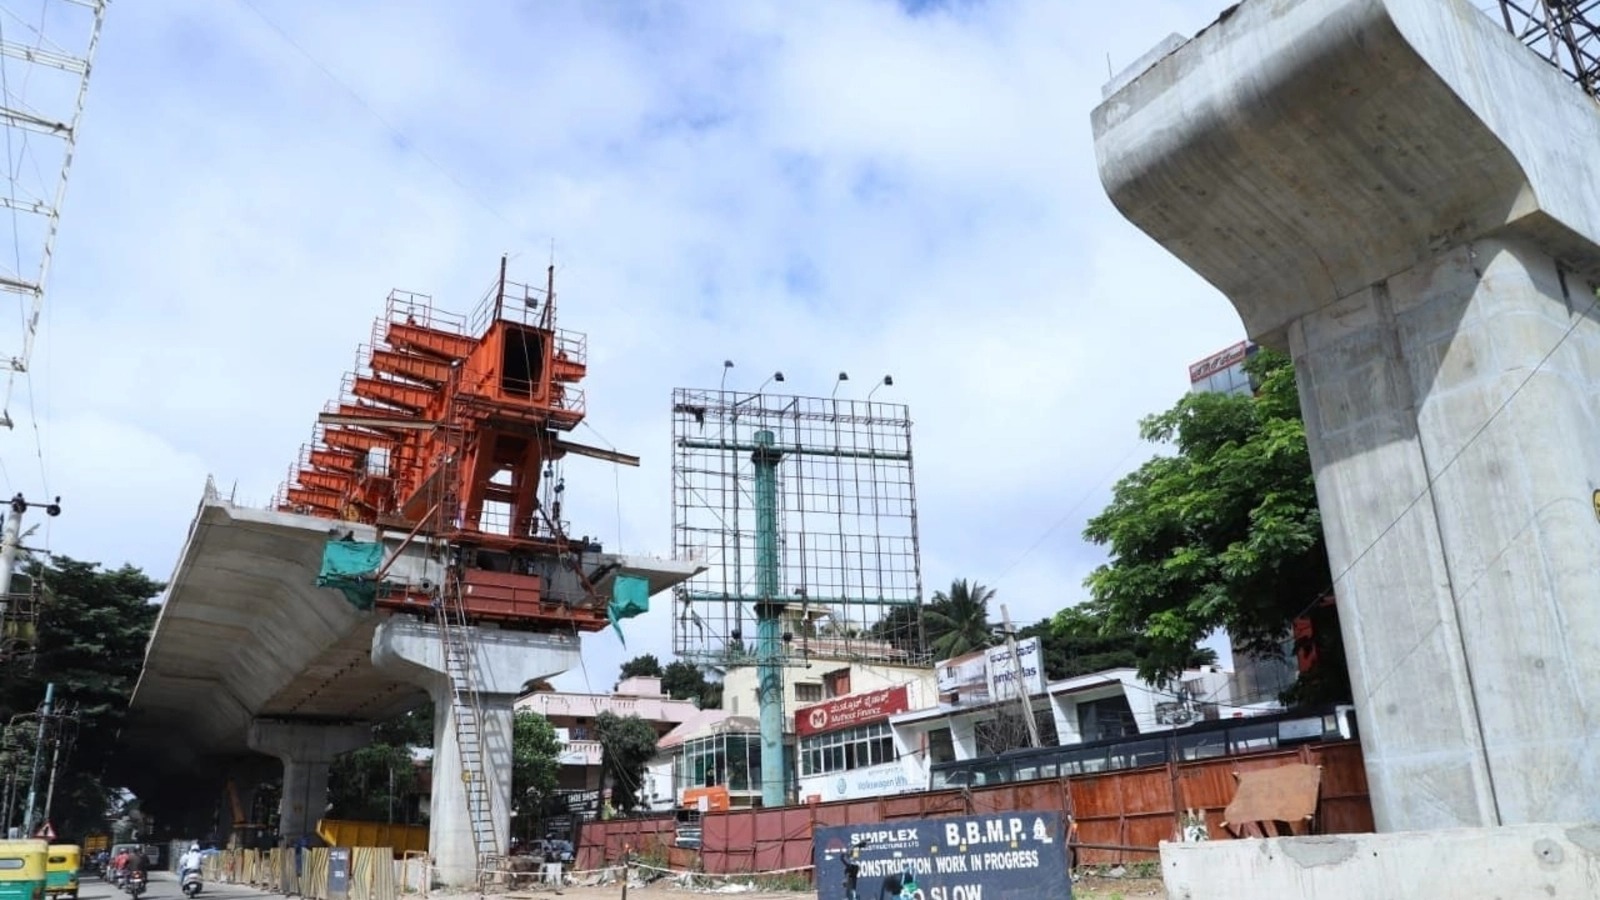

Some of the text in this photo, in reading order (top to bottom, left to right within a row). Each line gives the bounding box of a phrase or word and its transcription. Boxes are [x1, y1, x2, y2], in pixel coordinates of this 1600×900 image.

[857, 707, 881, 718] Finance
[850, 828, 918, 845] SIMPLEX
[945, 817, 1027, 847] B.B.M.P.
[935, 855, 968, 874] WORK
[970, 854, 982, 871] IN
[984, 849, 1040, 871] PROGRESS
[930, 883, 983, 900] SLOW
